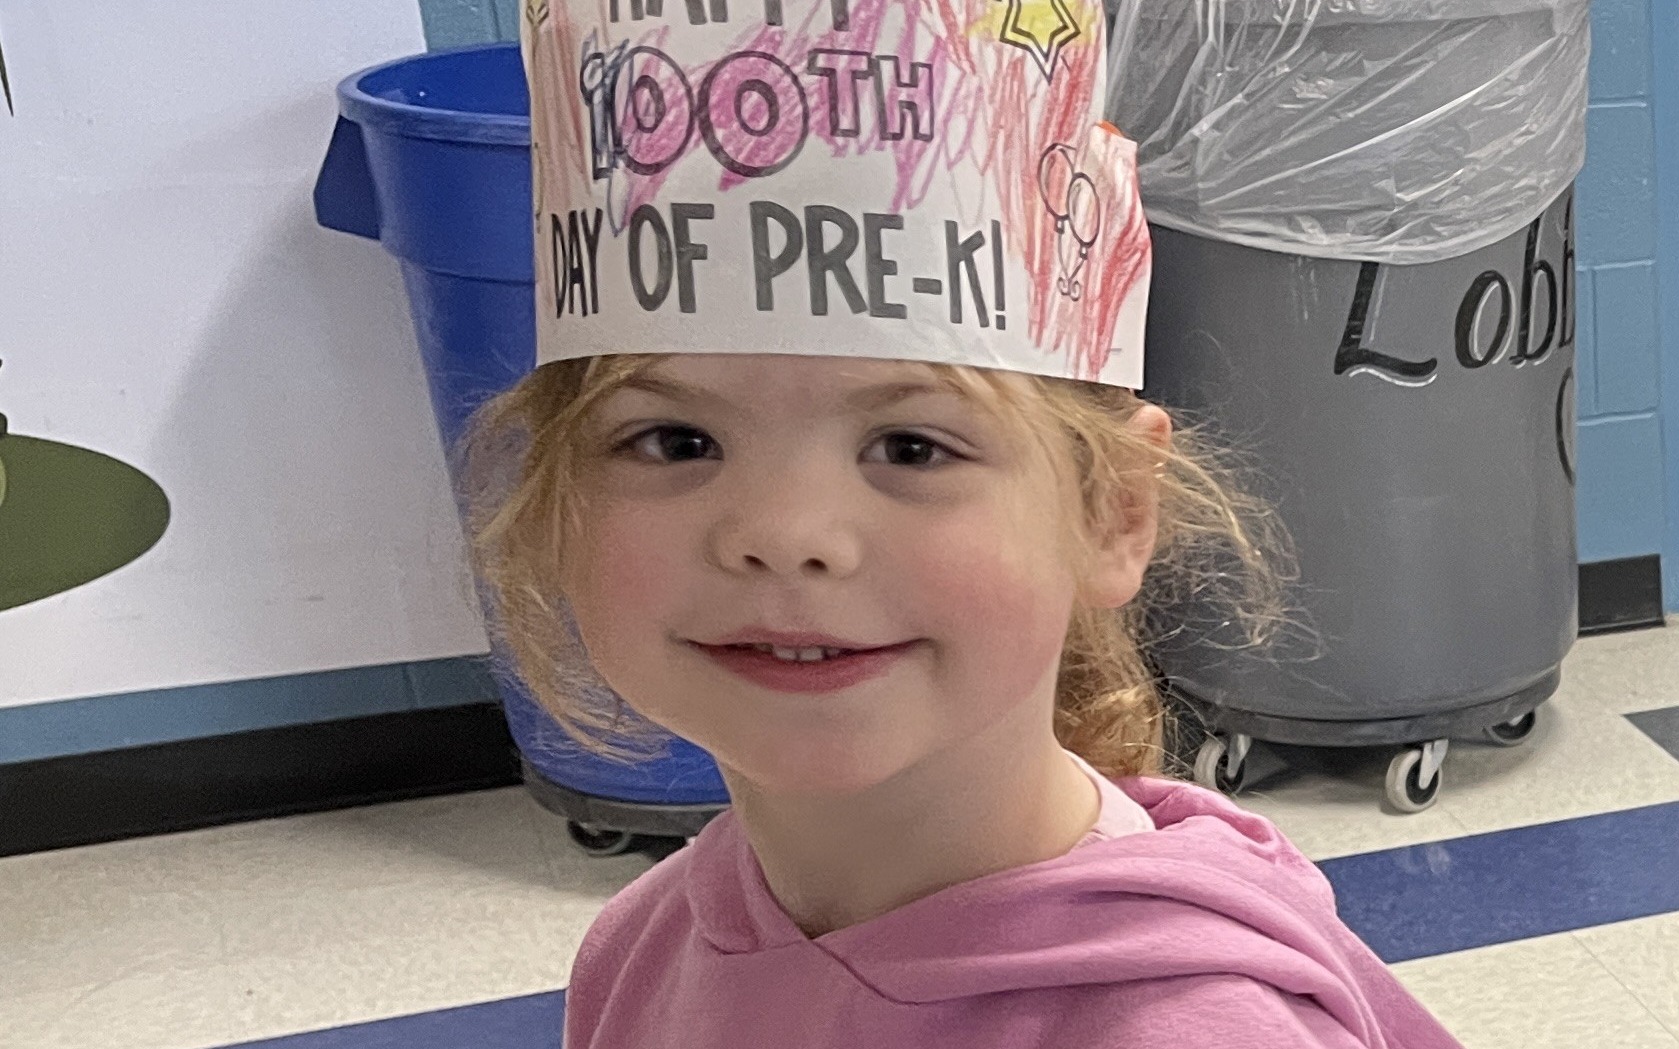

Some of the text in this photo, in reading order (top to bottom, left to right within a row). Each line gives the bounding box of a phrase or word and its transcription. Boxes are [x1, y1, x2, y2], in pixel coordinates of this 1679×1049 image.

[580, 47, 934, 179] 100TH
[551, 200, 1006, 330] DAY OF PRE-K!
